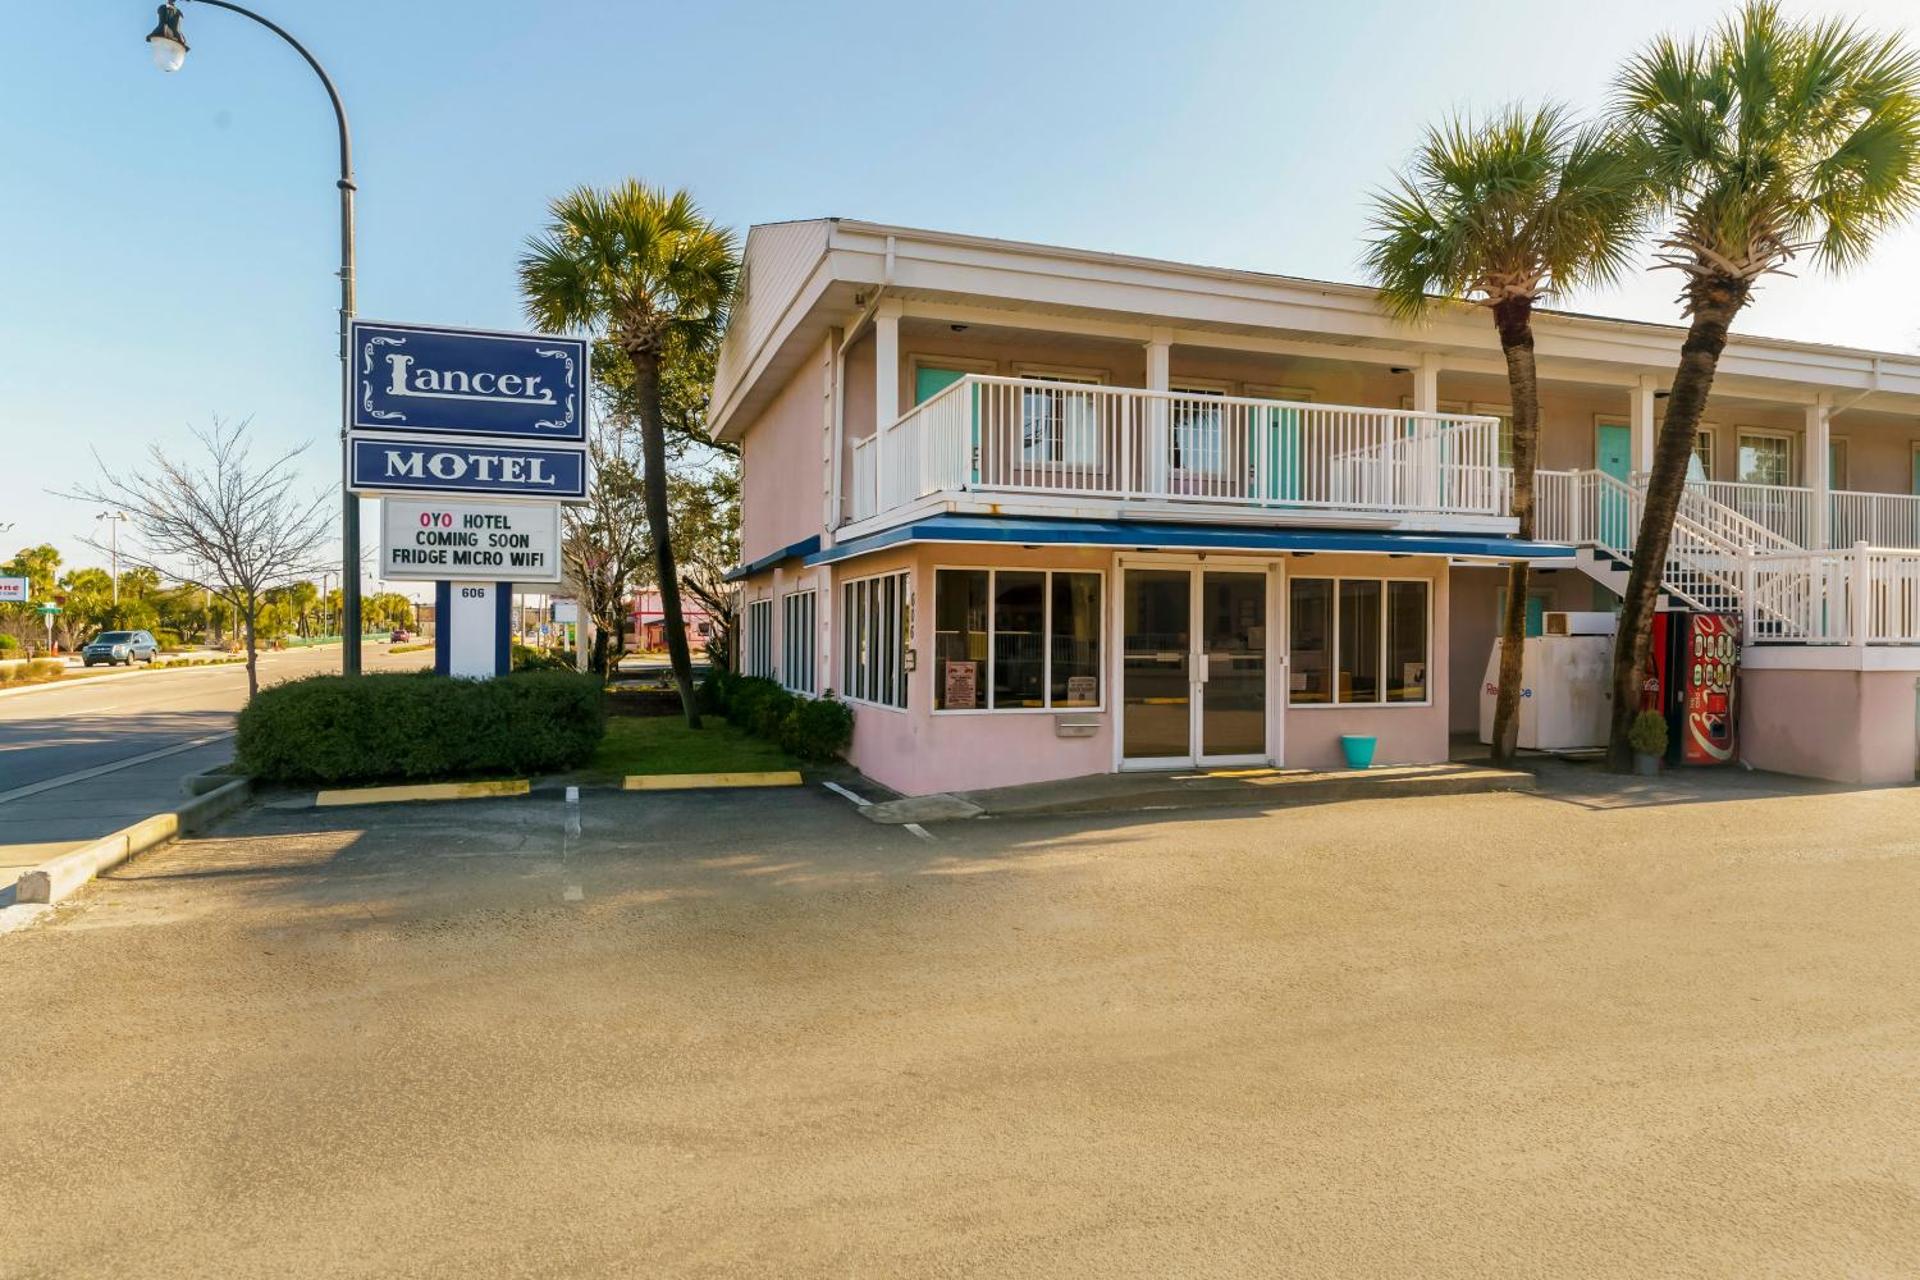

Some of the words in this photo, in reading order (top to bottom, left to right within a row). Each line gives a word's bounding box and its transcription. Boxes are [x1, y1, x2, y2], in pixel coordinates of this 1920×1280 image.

[385, 353, 557, 405] Lancer
[384, 450, 555, 485] MOTEL
[420, 512, 453, 528] OYO
[464, 514, 511, 530] HOTEL
[416, 531, 478, 547] COMING
[489, 534, 529, 548] SOON
[392, 549, 447, 564] FRIDGE
[453, 551, 503, 565] MICRO
[511, 552, 544, 566] WIFI
[462, 588, 485, 598] 606
